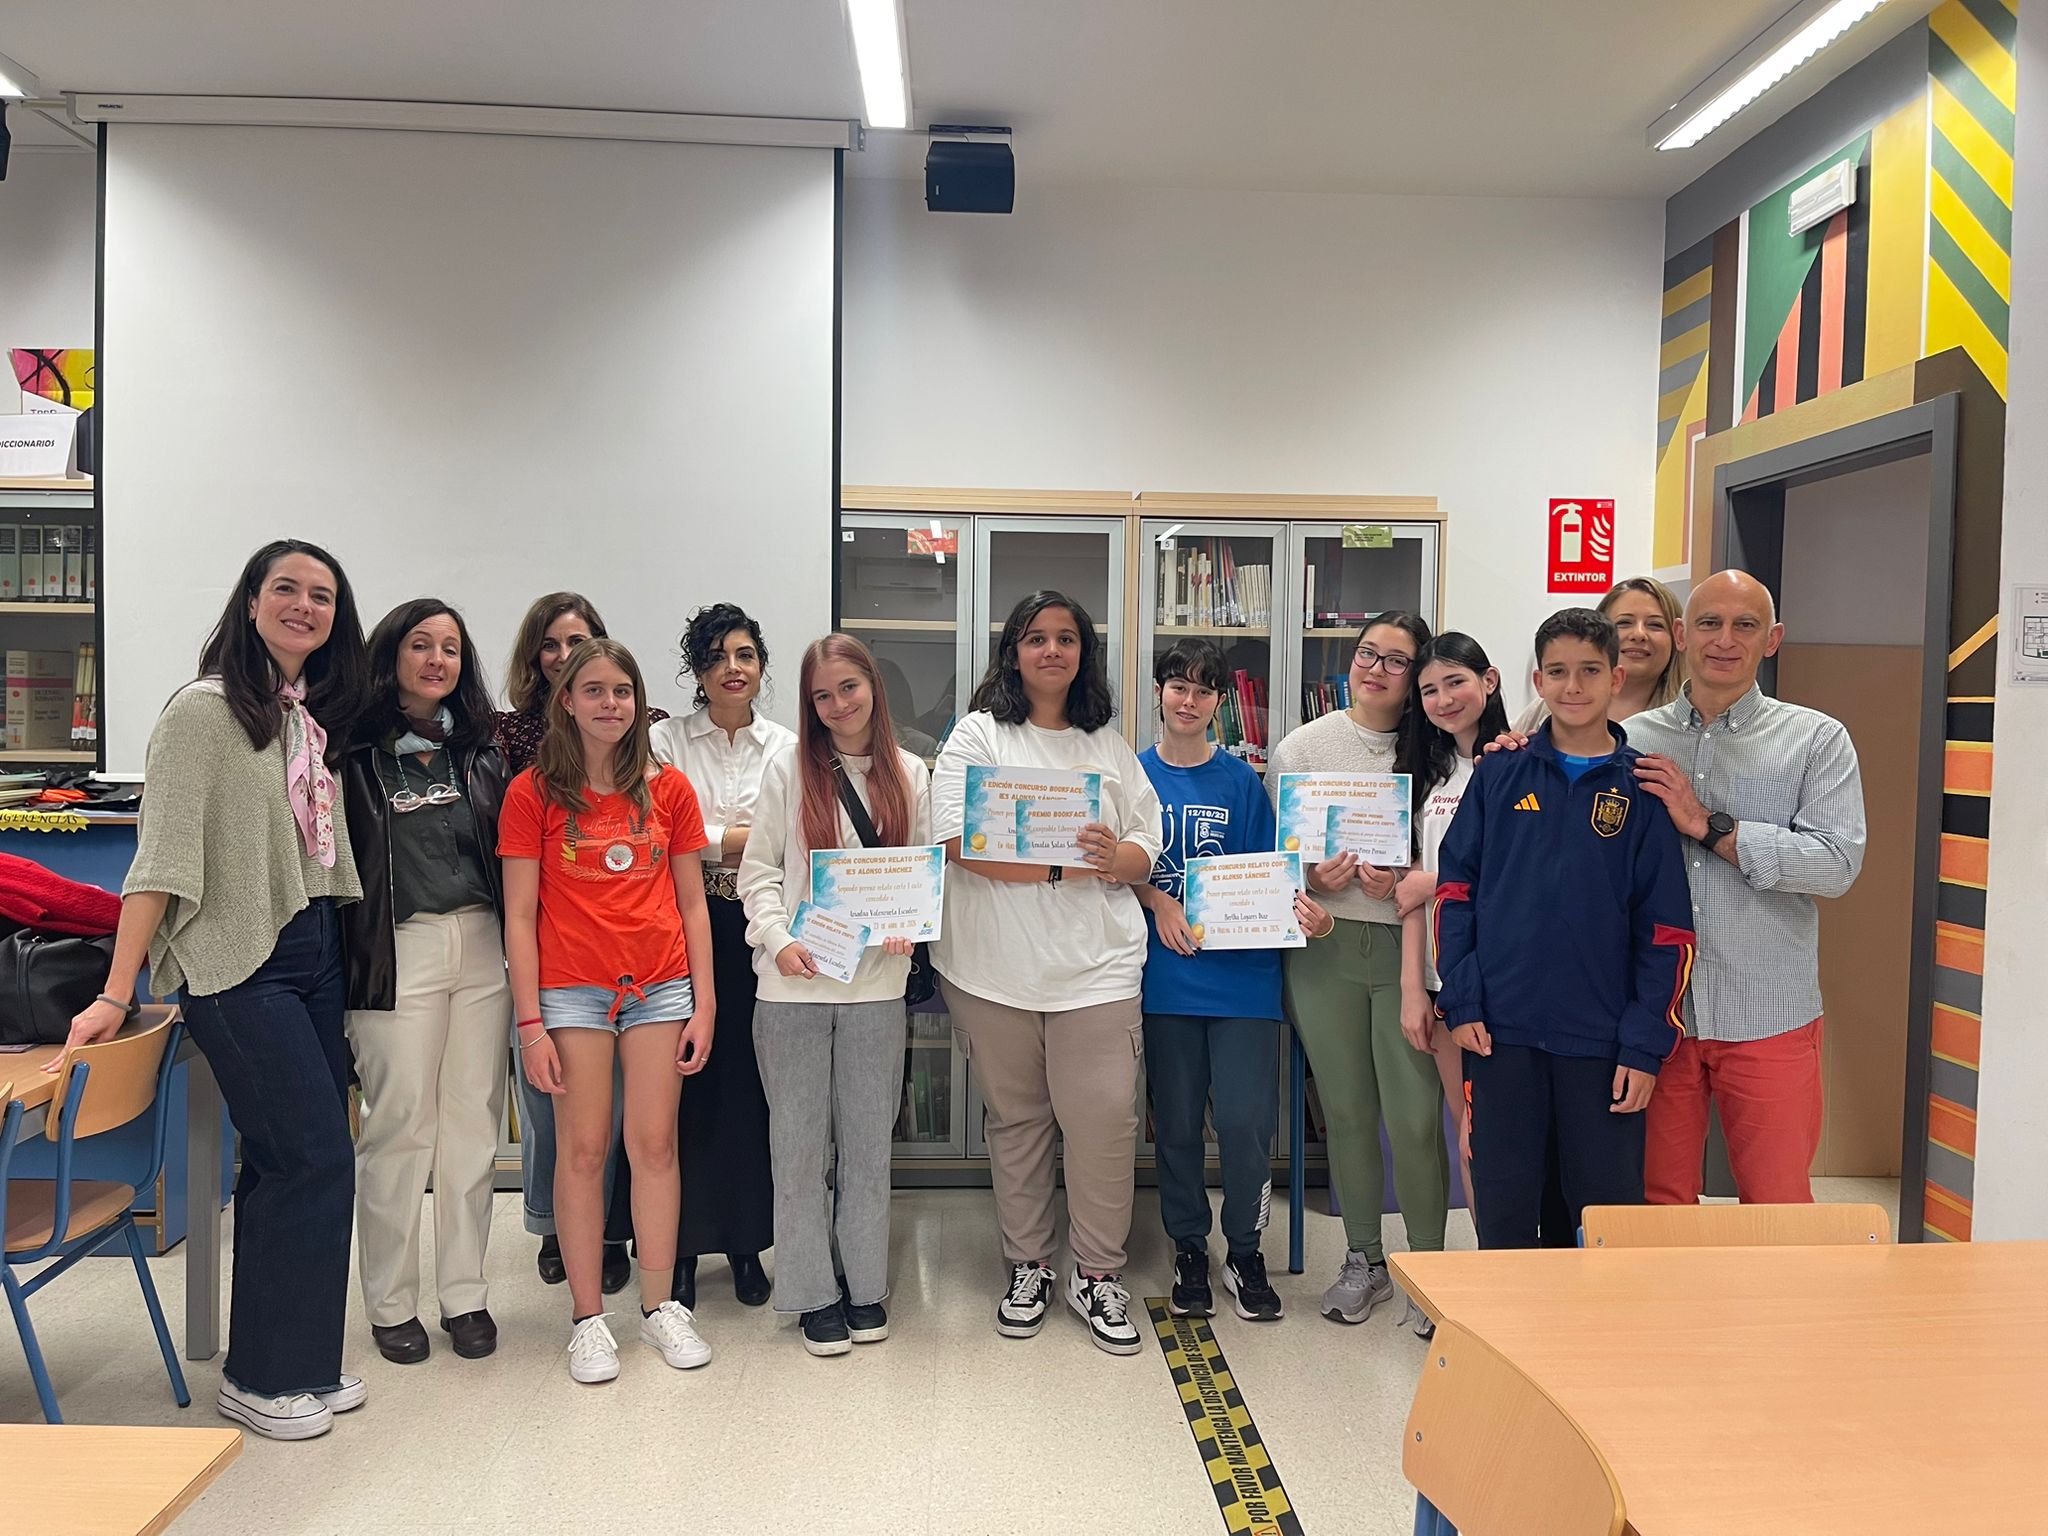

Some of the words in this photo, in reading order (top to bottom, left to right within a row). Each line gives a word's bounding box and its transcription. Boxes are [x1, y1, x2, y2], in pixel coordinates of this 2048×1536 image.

[0, 440, 55, 448] ICCIONARIOS
[1554, 572, 1606, 582] EXTINTOR
[988, 781, 1012, 789] EDICIÓN
[1014, 783, 1047, 791] CONCURSO
[1349, 790, 1377, 798] SÁNCHEZ
[1188, 809, 1225, 820] 12/10/22
[1435, 806, 1446, 815] la
[888, 855, 913, 863] RELATO
[1186, 1353, 1205, 1362] DE
[1190, 1363, 1222, 1403] DISTANCIA
[1206, 1405, 1227, 1415] LA
[1211, 1417, 1248, 1465] MANTENGA
[1232, 1467, 1263, 1498] FAVOR
[1245, 1502, 1273, 1523] POR
